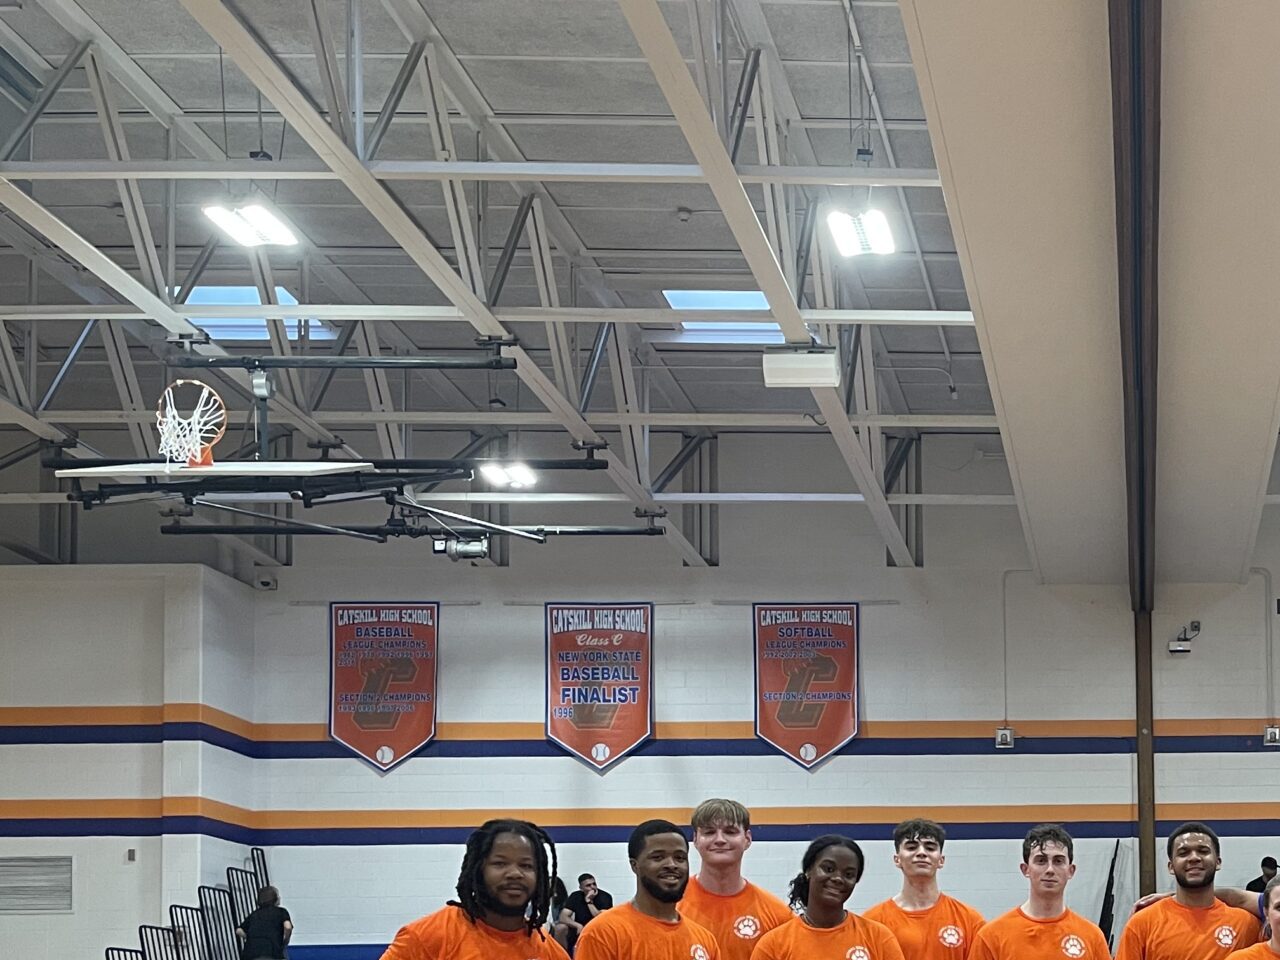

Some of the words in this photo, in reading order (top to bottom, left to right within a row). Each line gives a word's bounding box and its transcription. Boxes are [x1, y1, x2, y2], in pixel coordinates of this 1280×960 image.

[338, 610, 378, 626] CATSKILL
[380, 610, 400, 622] HIGH
[402, 610, 433, 626] SCHOOL
[552, 609, 592, 634] CATSKILL
[594, 609, 614, 630] HIGH
[615, 608, 646, 633] SCHOOL
[760, 610, 800, 626] CATSKILL
[801, 610, 821, 622] HIGH
[822, 610, 852, 626] SCHOOL
[355, 626, 414, 638] BASEBALL
[778, 626, 834, 638] SOFTBALL
[343, 640, 374, 650] LEAGUE
[378, 640, 427, 650] CHAMPIONS
[576, 634, 609, 646] Class
[610, 634, 623, 646] C
[765, 640, 797, 650] LEAGUE
[799, 640, 848, 650] CHAMPIONS
[558, 652, 580, 662] NEW
[582, 652, 609, 662] YORK
[612, 651, 642, 662] STATE
[560, 666, 640, 682] BASEBALL
[339, 693, 374, 702] SECTION
[383, 693, 432, 702] CHAMPIONS
[560, 686, 640, 704] FINALIST
[763, 692, 797, 702] SECTION
[798, 692, 804, 701] 2
[805, 692, 852, 701] CHAMPIONS
[553, 706, 573, 719] 1996
